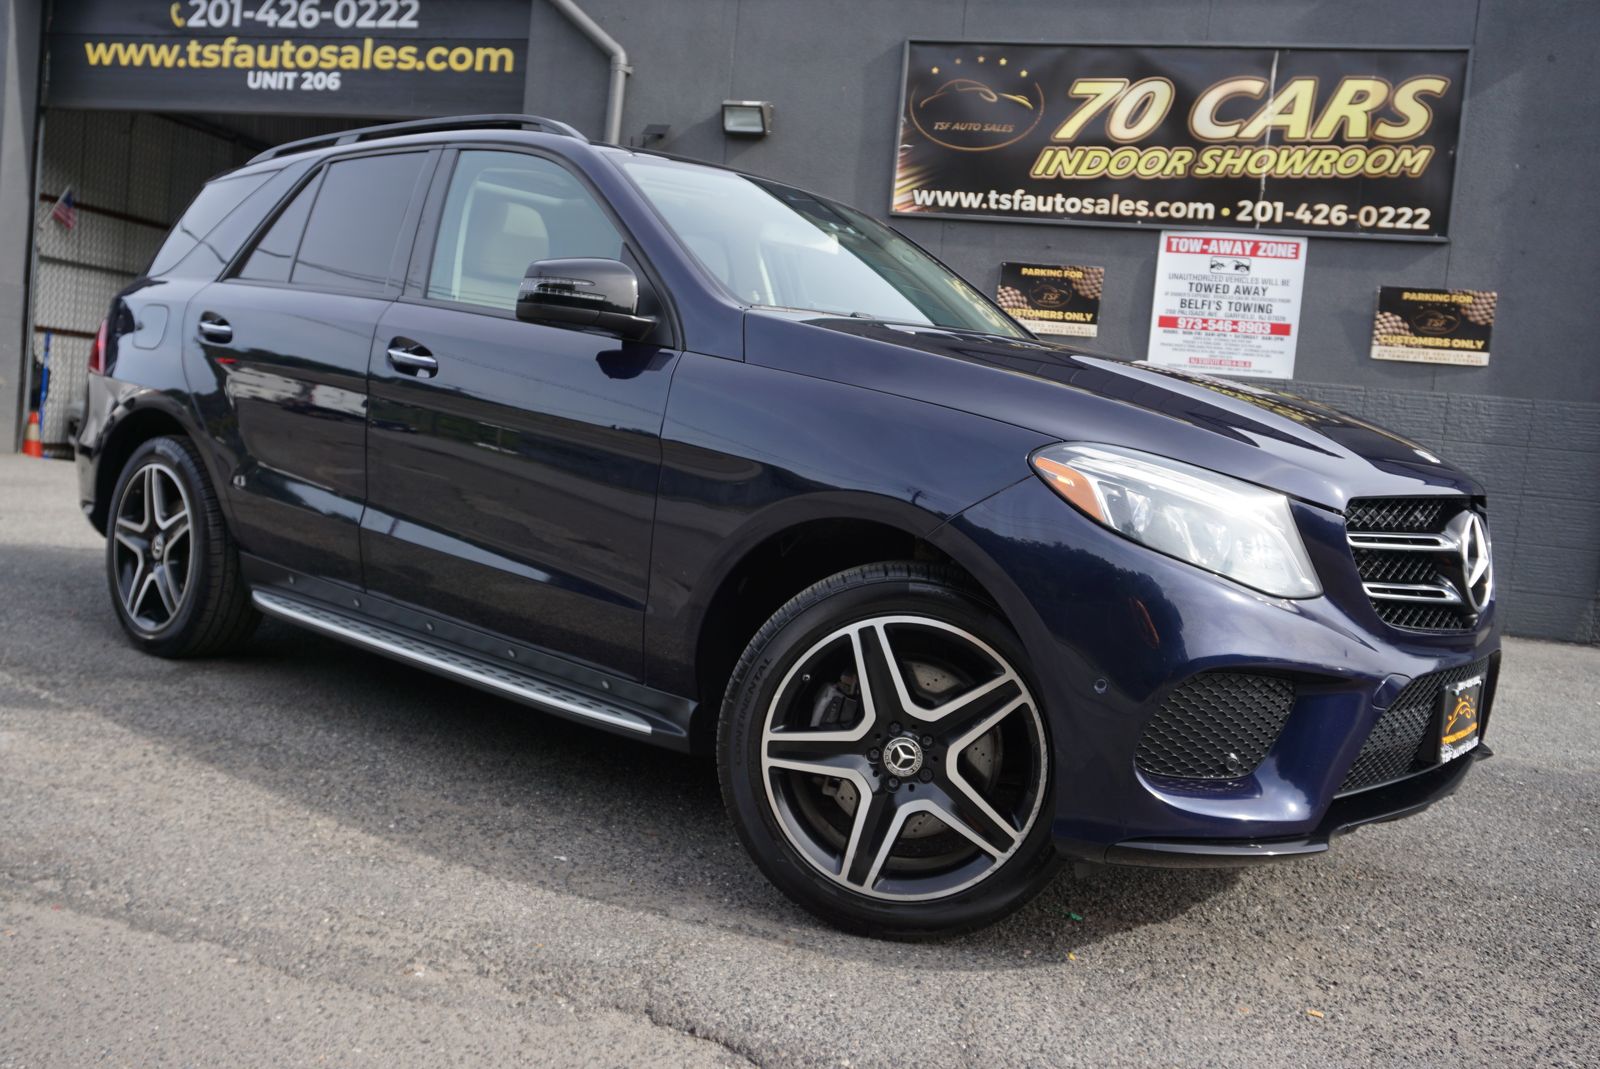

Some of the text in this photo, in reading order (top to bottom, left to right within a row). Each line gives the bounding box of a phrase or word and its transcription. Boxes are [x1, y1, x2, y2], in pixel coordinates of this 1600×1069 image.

[187, 0, 419, 29] 201-426-0222
[85, 37, 514, 73] www.tsfautosales.com
[247, 70, 341, 91] UNIT 206
[1052, 74, 1451, 143] 70 CARS
[934, 121, 1016, 133] TSF AUTO SALES
[1030, 145, 1434, 179] INDOOR SHOWROOM
[912, 188, 1431, 231] www.tsfautosales.com 201-426-0222
[1170, 237, 1297, 258] TOW-AWAY ZONE
[1021, 267, 1084, 279] PARKING FOR
[1188, 282, 1230, 295] TOWED
[1234, 284, 1269, 297] AWAY
[1402, 291, 1474, 304] PARKING FOR
[1064, 311, 1093, 321] ONLY
[1179, 298, 1273, 315] BELFI'S TOWING
[1380, 335, 1484, 350] CUSTOMERS ONLY
